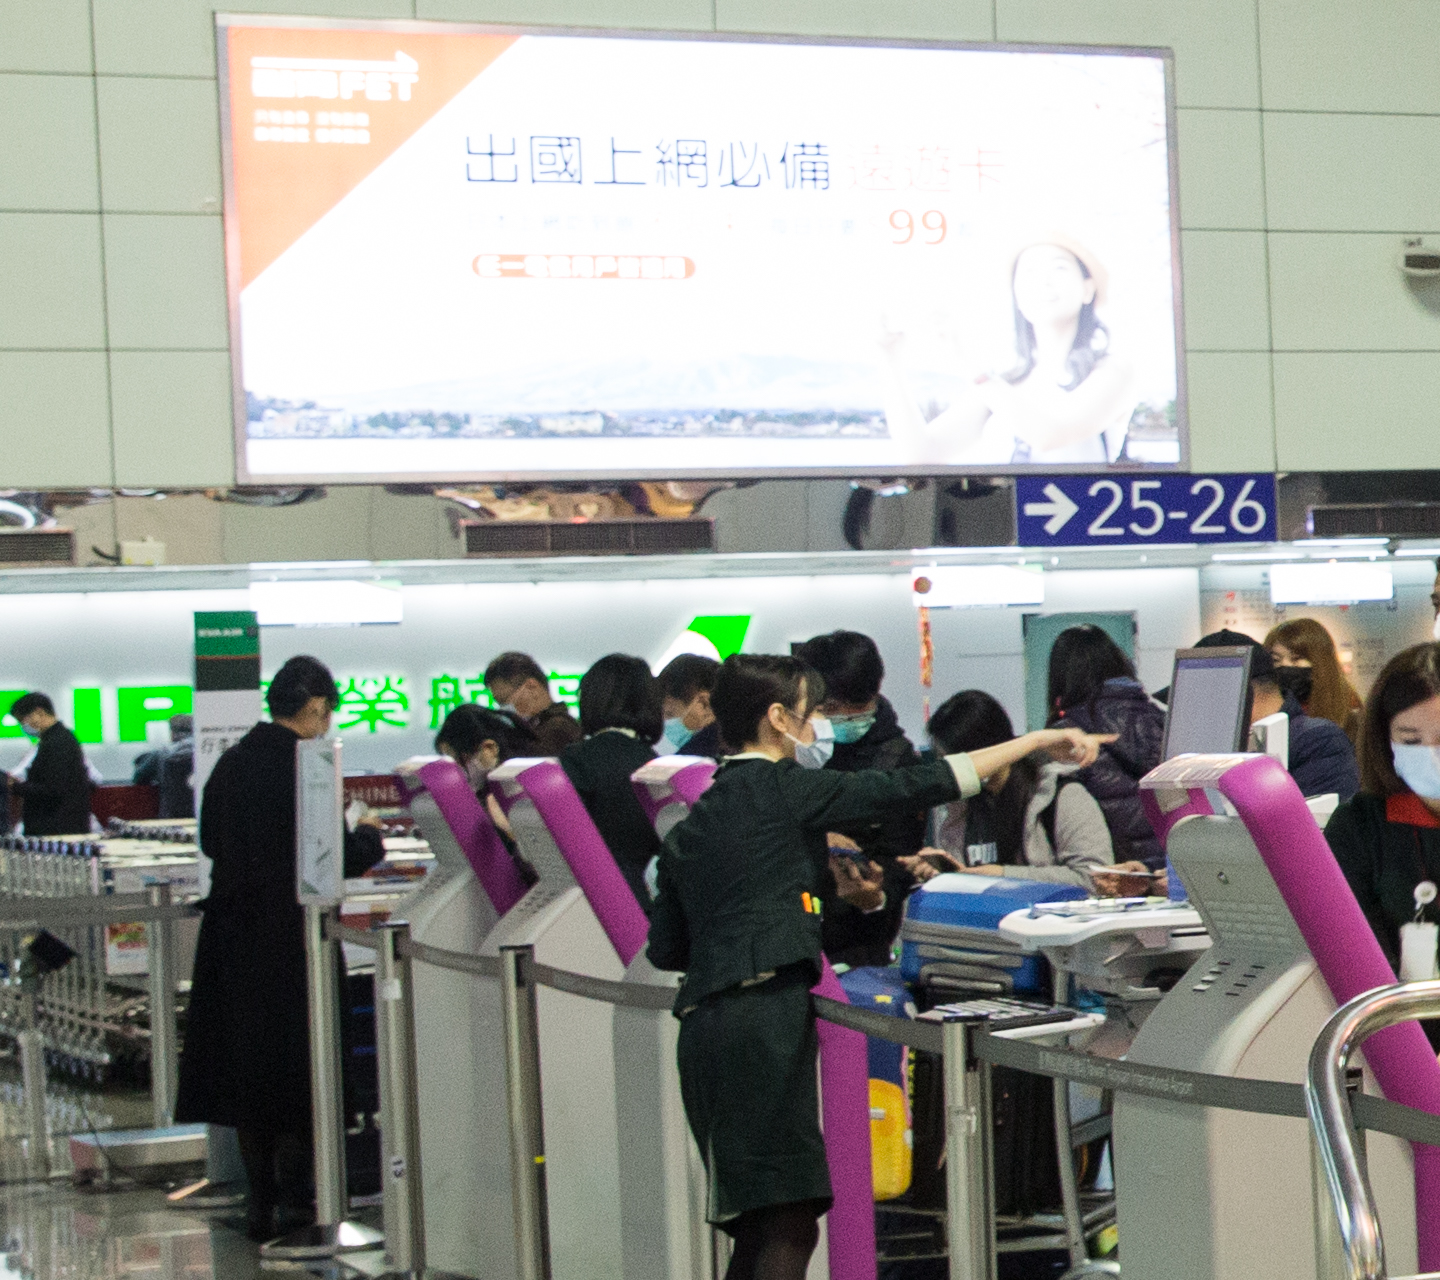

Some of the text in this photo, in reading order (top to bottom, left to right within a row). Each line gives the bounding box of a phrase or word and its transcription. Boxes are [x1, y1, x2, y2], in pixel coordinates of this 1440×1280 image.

[466, 134, 831, 190] 出國上網必備
[888, 208, 948, 246] 99
[1086, 478, 1267, 537] 25-26
